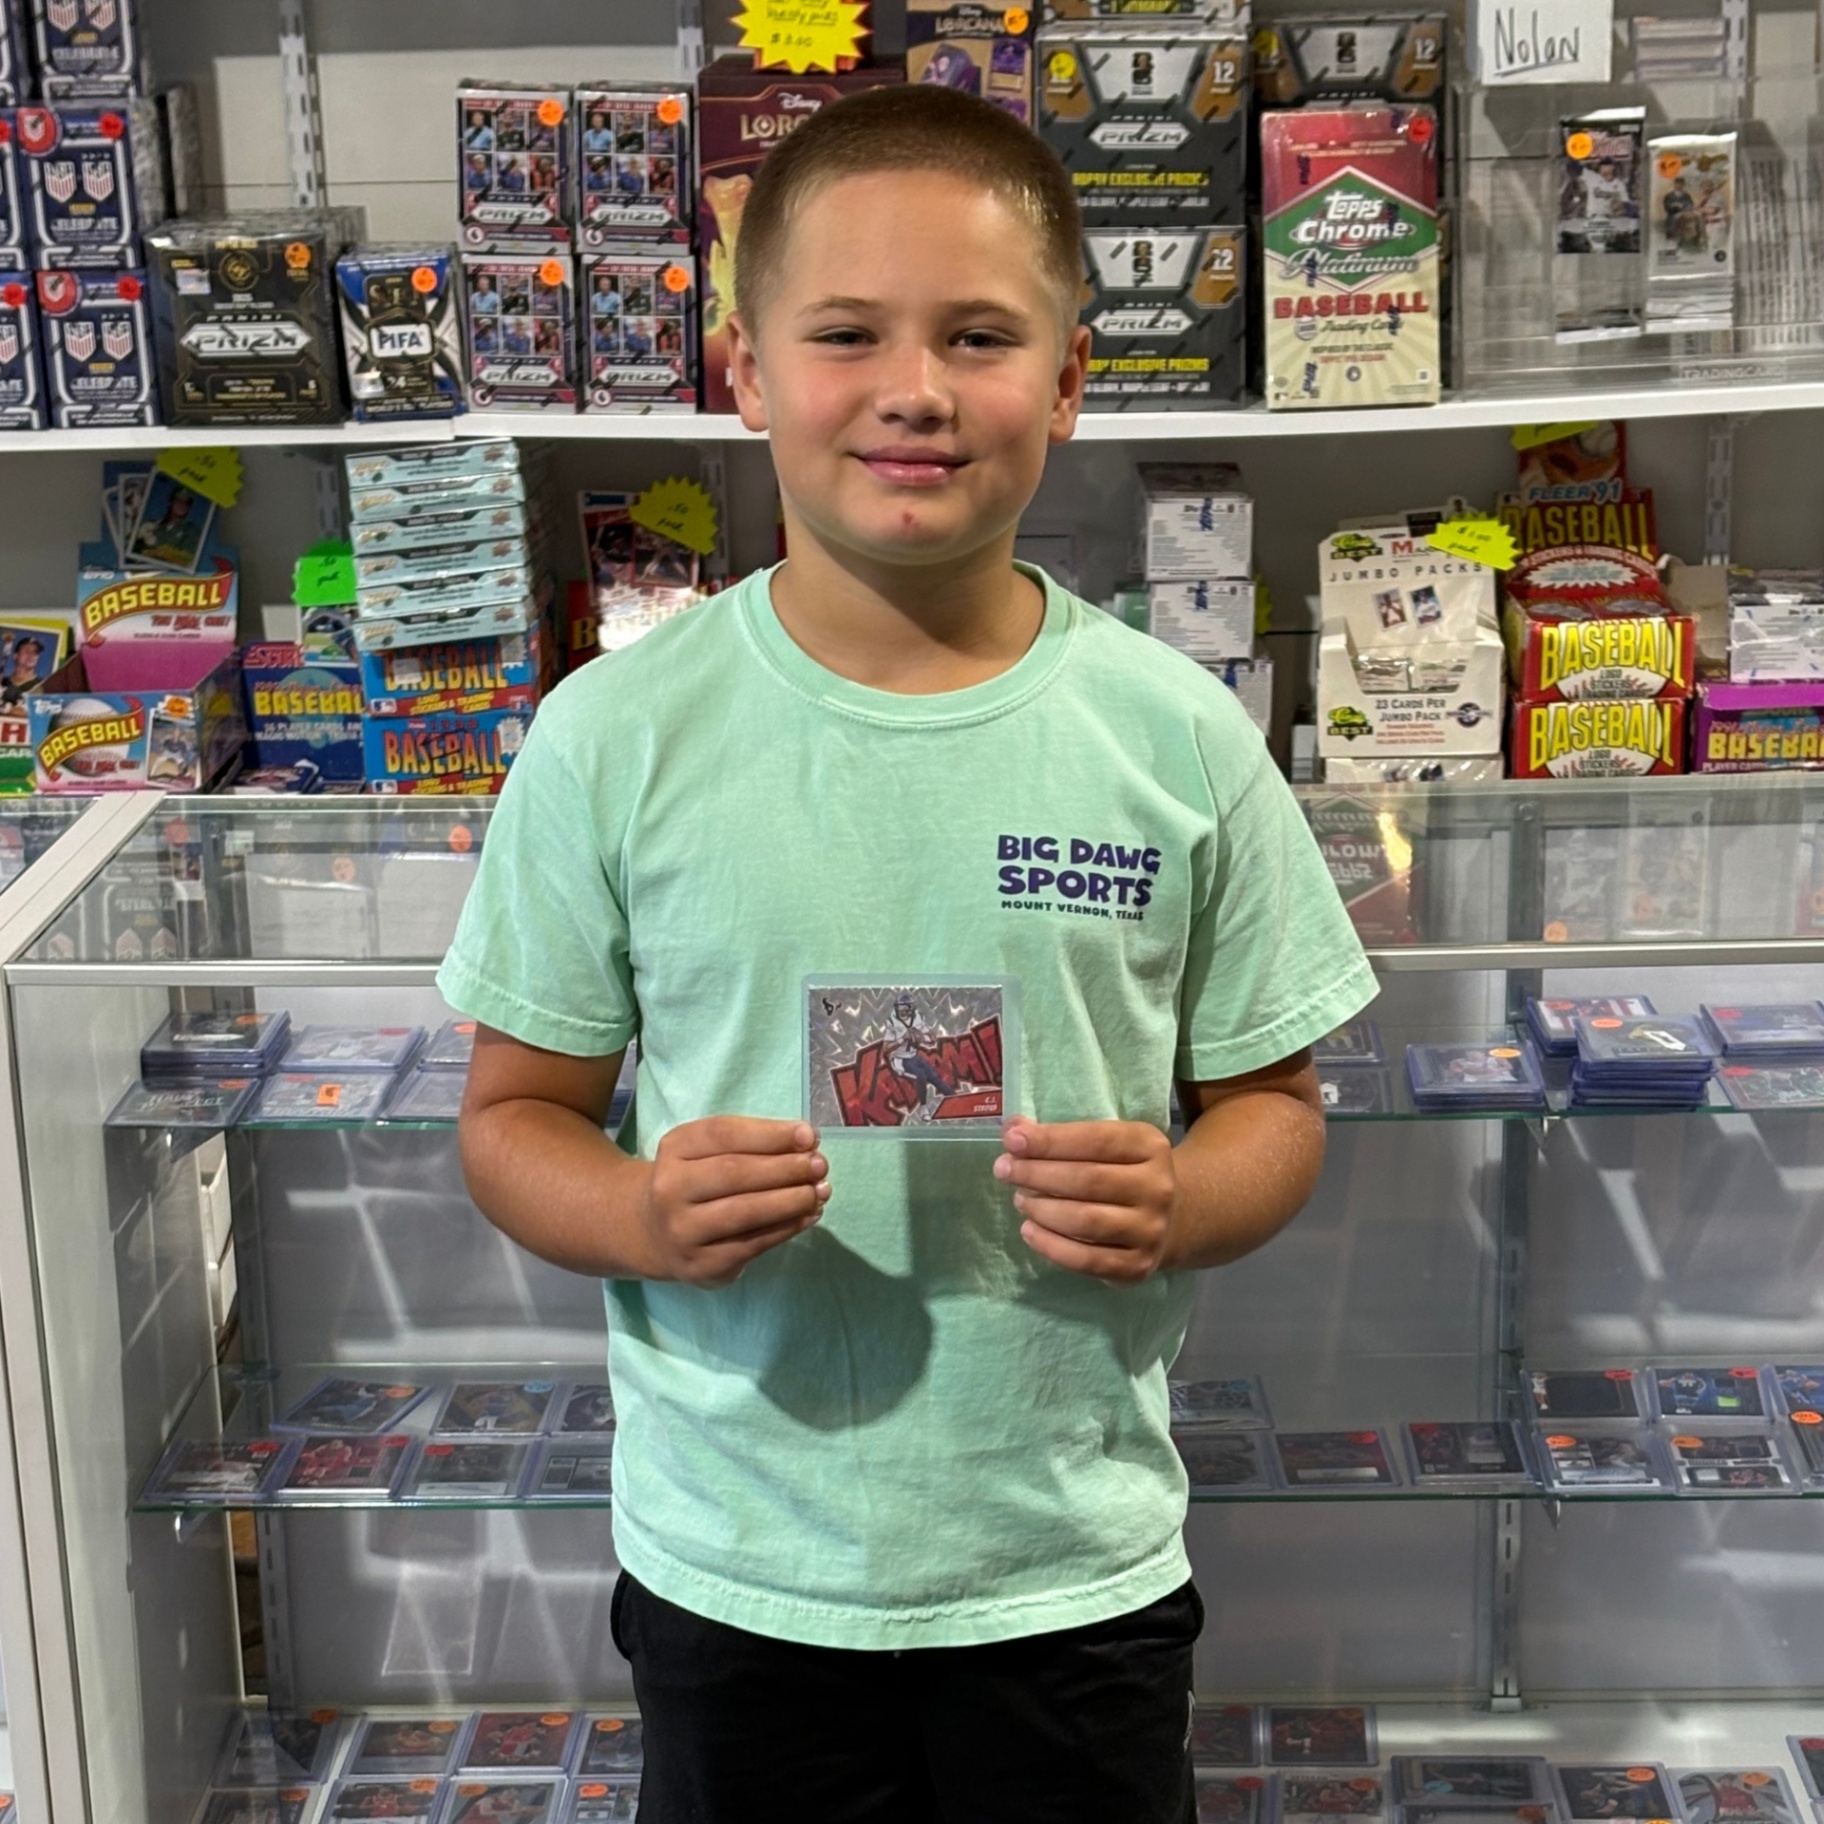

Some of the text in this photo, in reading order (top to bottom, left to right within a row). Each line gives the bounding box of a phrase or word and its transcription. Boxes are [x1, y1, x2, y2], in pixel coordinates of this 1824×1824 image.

[1414, 38, 1436, 60] 12
[1495, 7, 1580, 70] Nolan
[1213, 61, 1235, 83] 12
[1325, 191, 1385, 220] Topps
[1299, 220, 1409, 243] Chrome
[1280, 248, 1419, 279] Platinum
[1273, 291, 1429, 319] BASEBALL
[198, 333, 297, 349] PRIZM
[1530, 487, 1591, 500] FLEER
[1504, 503, 1654, 563] BASEBALL
[1329, 562, 1483, 582] JUMBO PACKS
[83, 581, 222, 630] BASEBALL
[1540, 620, 1686, 692] BASEBALL
[1376, 700, 1388, 709] 23
[40, 718, 142, 768] BASEBALL
[1329, 727, 1370, 735] BEST
[1529, 703, 1675, 772] BASEBALL
[384, 730, 508, 775] BASEBALL
[997, 834, 1163, 876] BIG DAWG
[997, 864, 1155, 907] SPORTS
[1001, 900, 1144, 921] MOUNT VERNON, TEXAS
